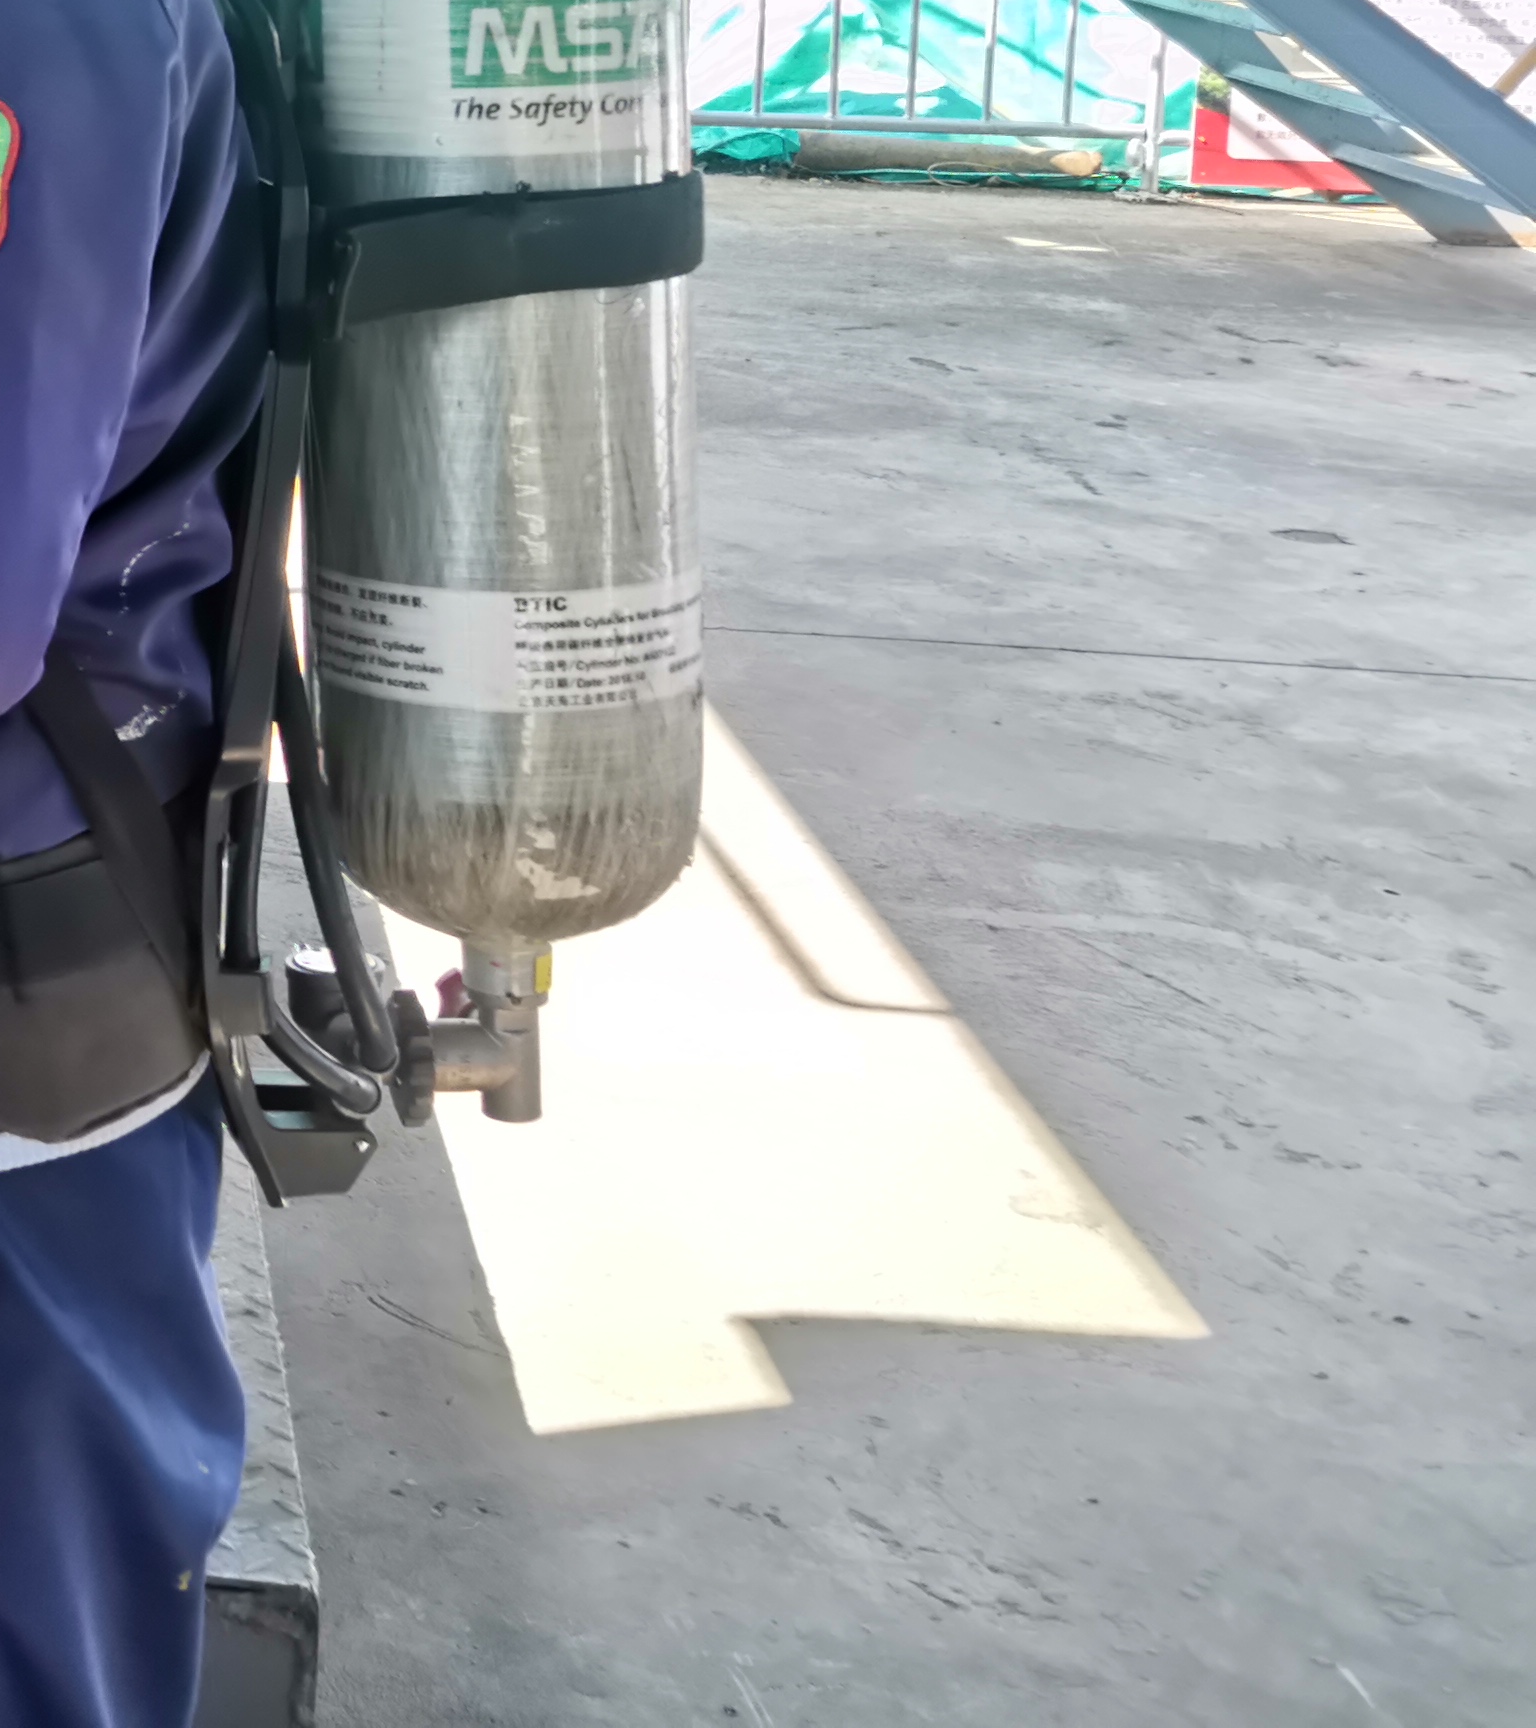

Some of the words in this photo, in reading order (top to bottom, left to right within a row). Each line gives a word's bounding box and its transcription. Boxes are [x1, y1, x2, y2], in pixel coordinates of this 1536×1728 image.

[451, 96, 501, 120] The
[508, 93, 593, 127] Safety
[381, 640, 427, 655] cylinder
[403, 660, 444, 675] broken
[386, 677, 430, 692] scratch.
